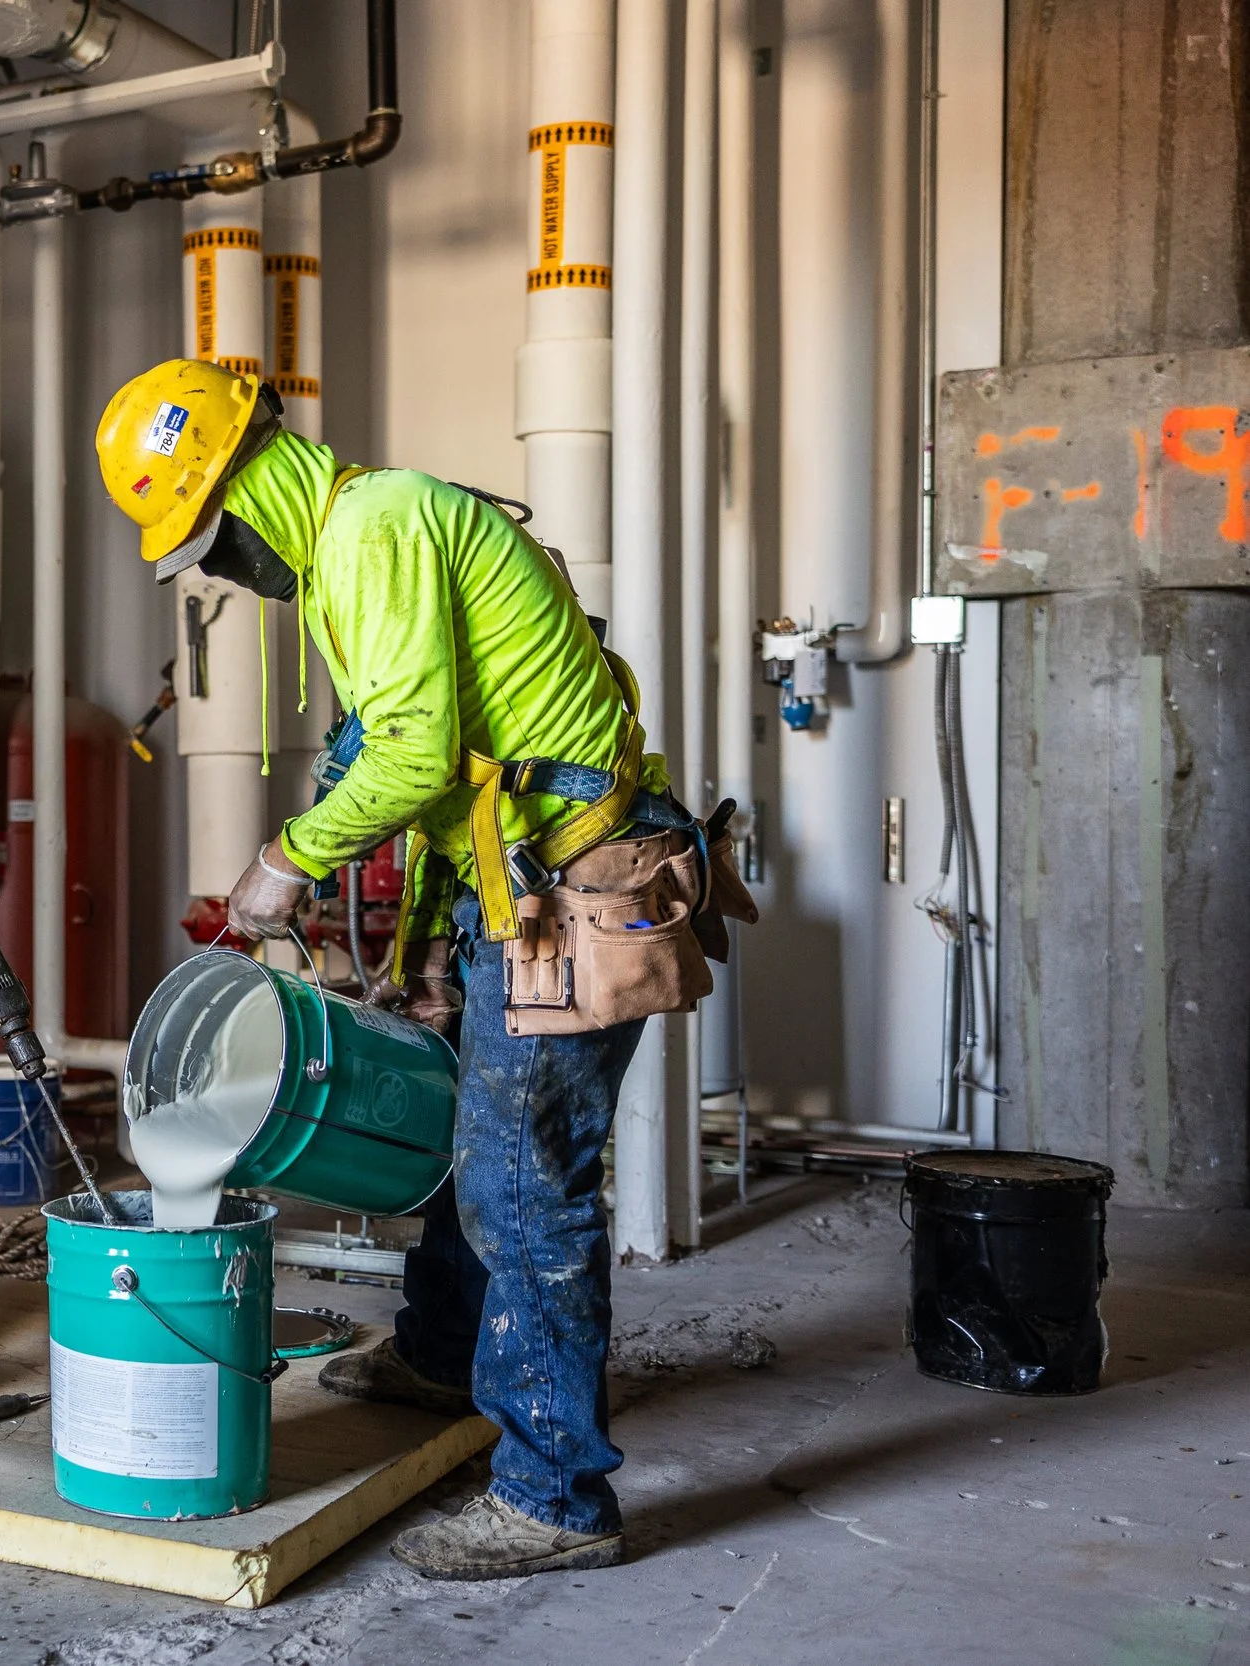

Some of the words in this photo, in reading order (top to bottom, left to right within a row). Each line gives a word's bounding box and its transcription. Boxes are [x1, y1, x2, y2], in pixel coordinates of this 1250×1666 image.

[544, 153, 559, 193] SUPPLY
[544, 196, 558, 235] WATER
[544, 238, 557, 260] HOT
[200, 258, 211, 277] HOT
[200, 280, 212, 312] WATER
[200, 315, 212, 353] RETURN
[159, 431, 175, 452] 784
